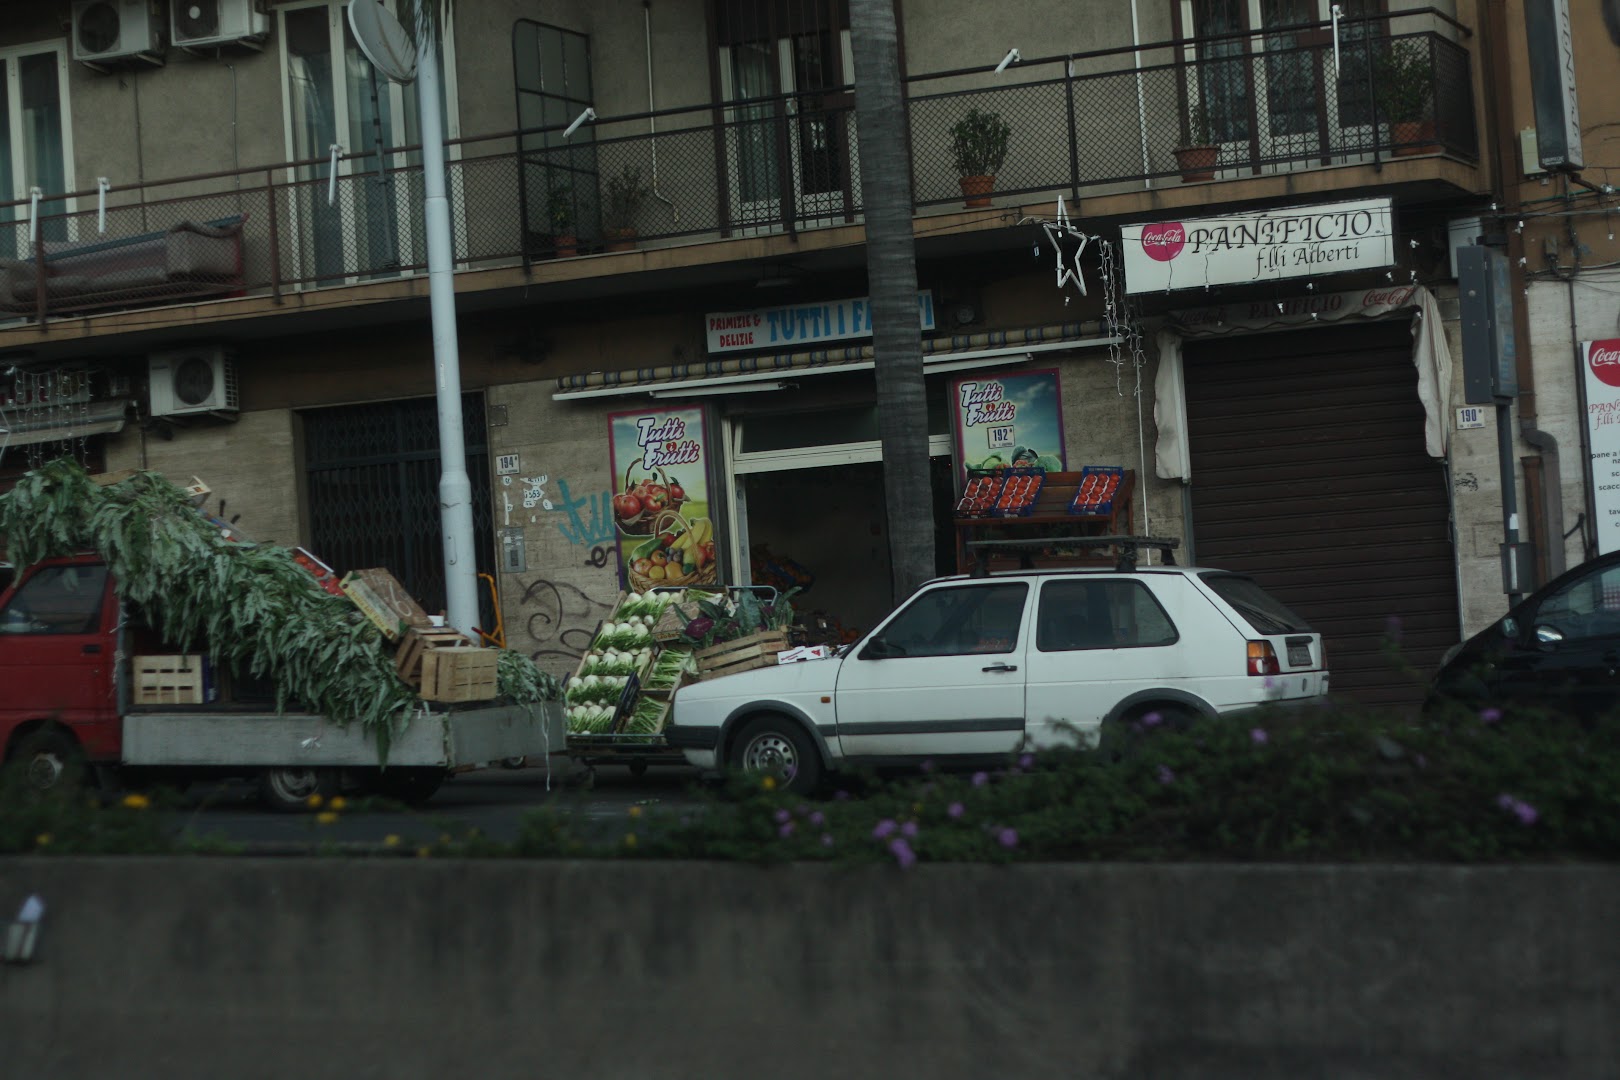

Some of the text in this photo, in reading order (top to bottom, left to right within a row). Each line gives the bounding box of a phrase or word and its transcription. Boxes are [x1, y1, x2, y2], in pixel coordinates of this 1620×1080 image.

[1143, 229, 1183, 246] Coca-Cola
[1189, 210, 1372, 254] PANIFICIO
[1294, 242, 1359, 266] Alberti
[710, 315, 761, 331] PRIMIZIE &
[767, 305, 831, 342] TUTTI
[719, 332, 754, 347] DELIZIE
[961, 382, 1002, 408] Tutti
[966, 401, 1016, 427] Frutti
[1460, 409, 1477, 422] 190
[637, 417, 685, 447] Tutti
[993, 428, 1008, 441] 192
[500, 456, 514, 469] 194
[643, 440, 700, 470] Frutti
